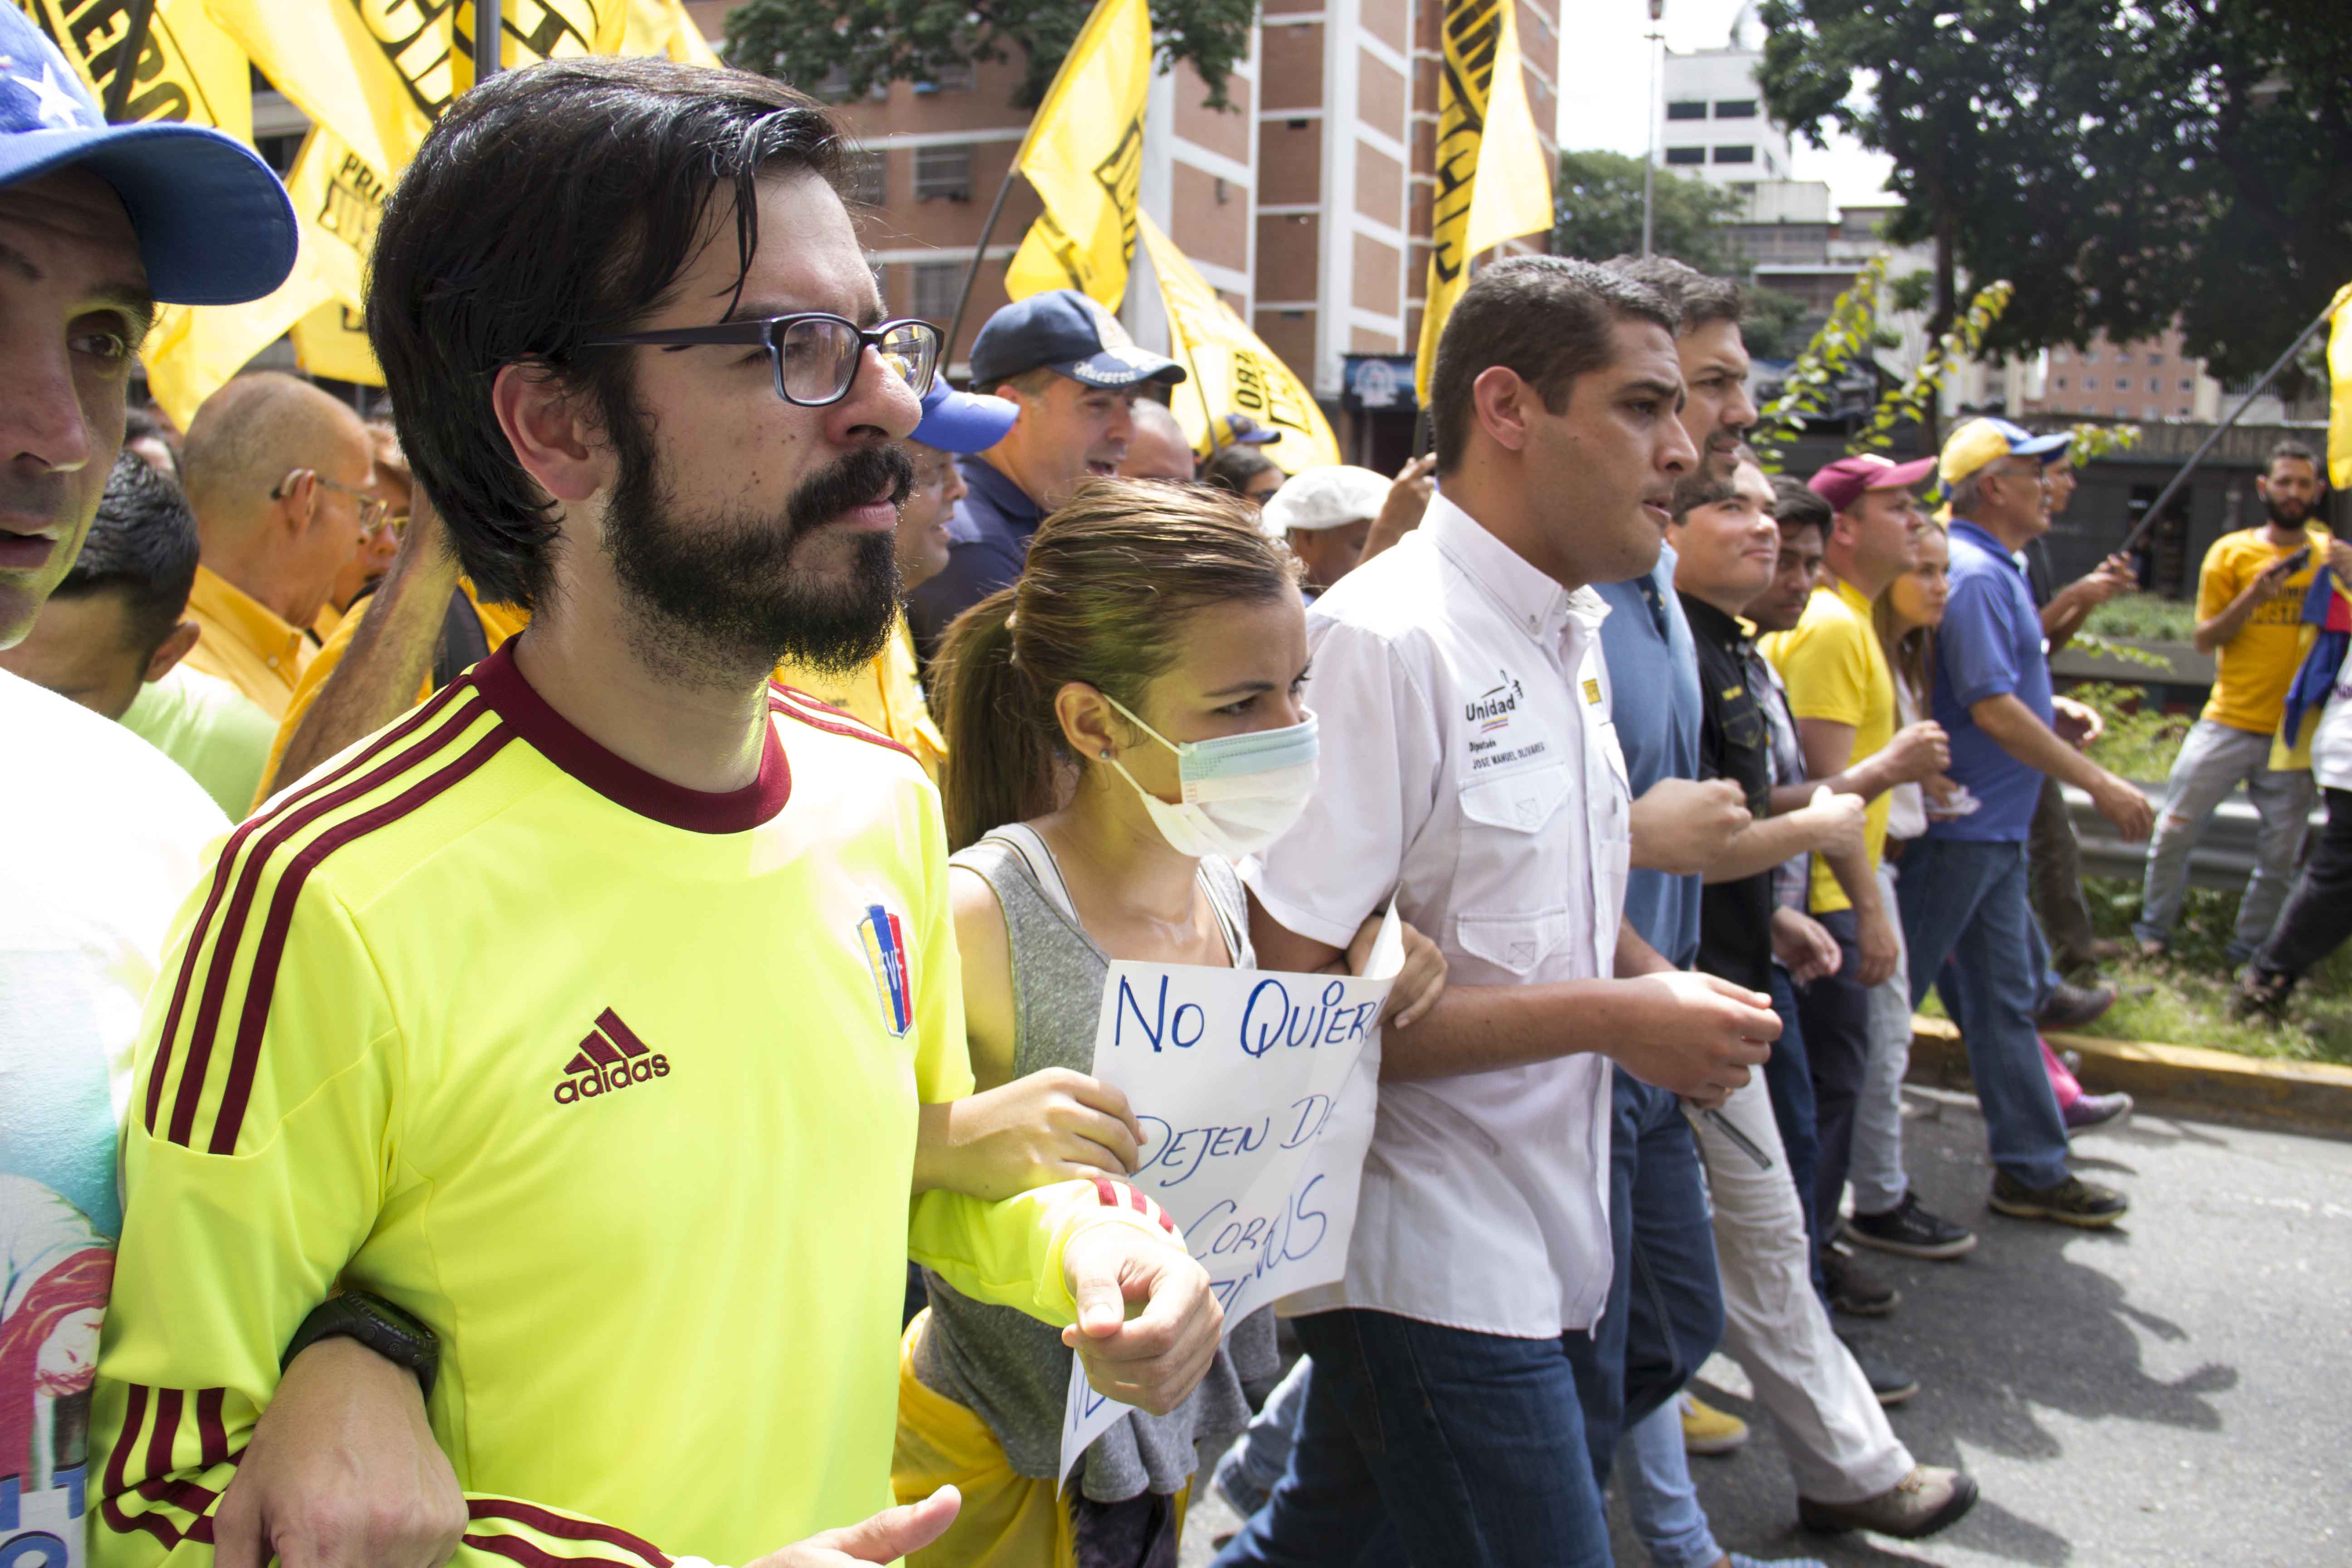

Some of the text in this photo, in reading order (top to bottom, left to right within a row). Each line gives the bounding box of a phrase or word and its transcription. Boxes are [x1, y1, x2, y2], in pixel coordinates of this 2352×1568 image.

[1466, 694, 1515, 721] Unidad
[1473, 757, 1491, 770] JOSE
[554, 1054, 671, 1104] adidas
